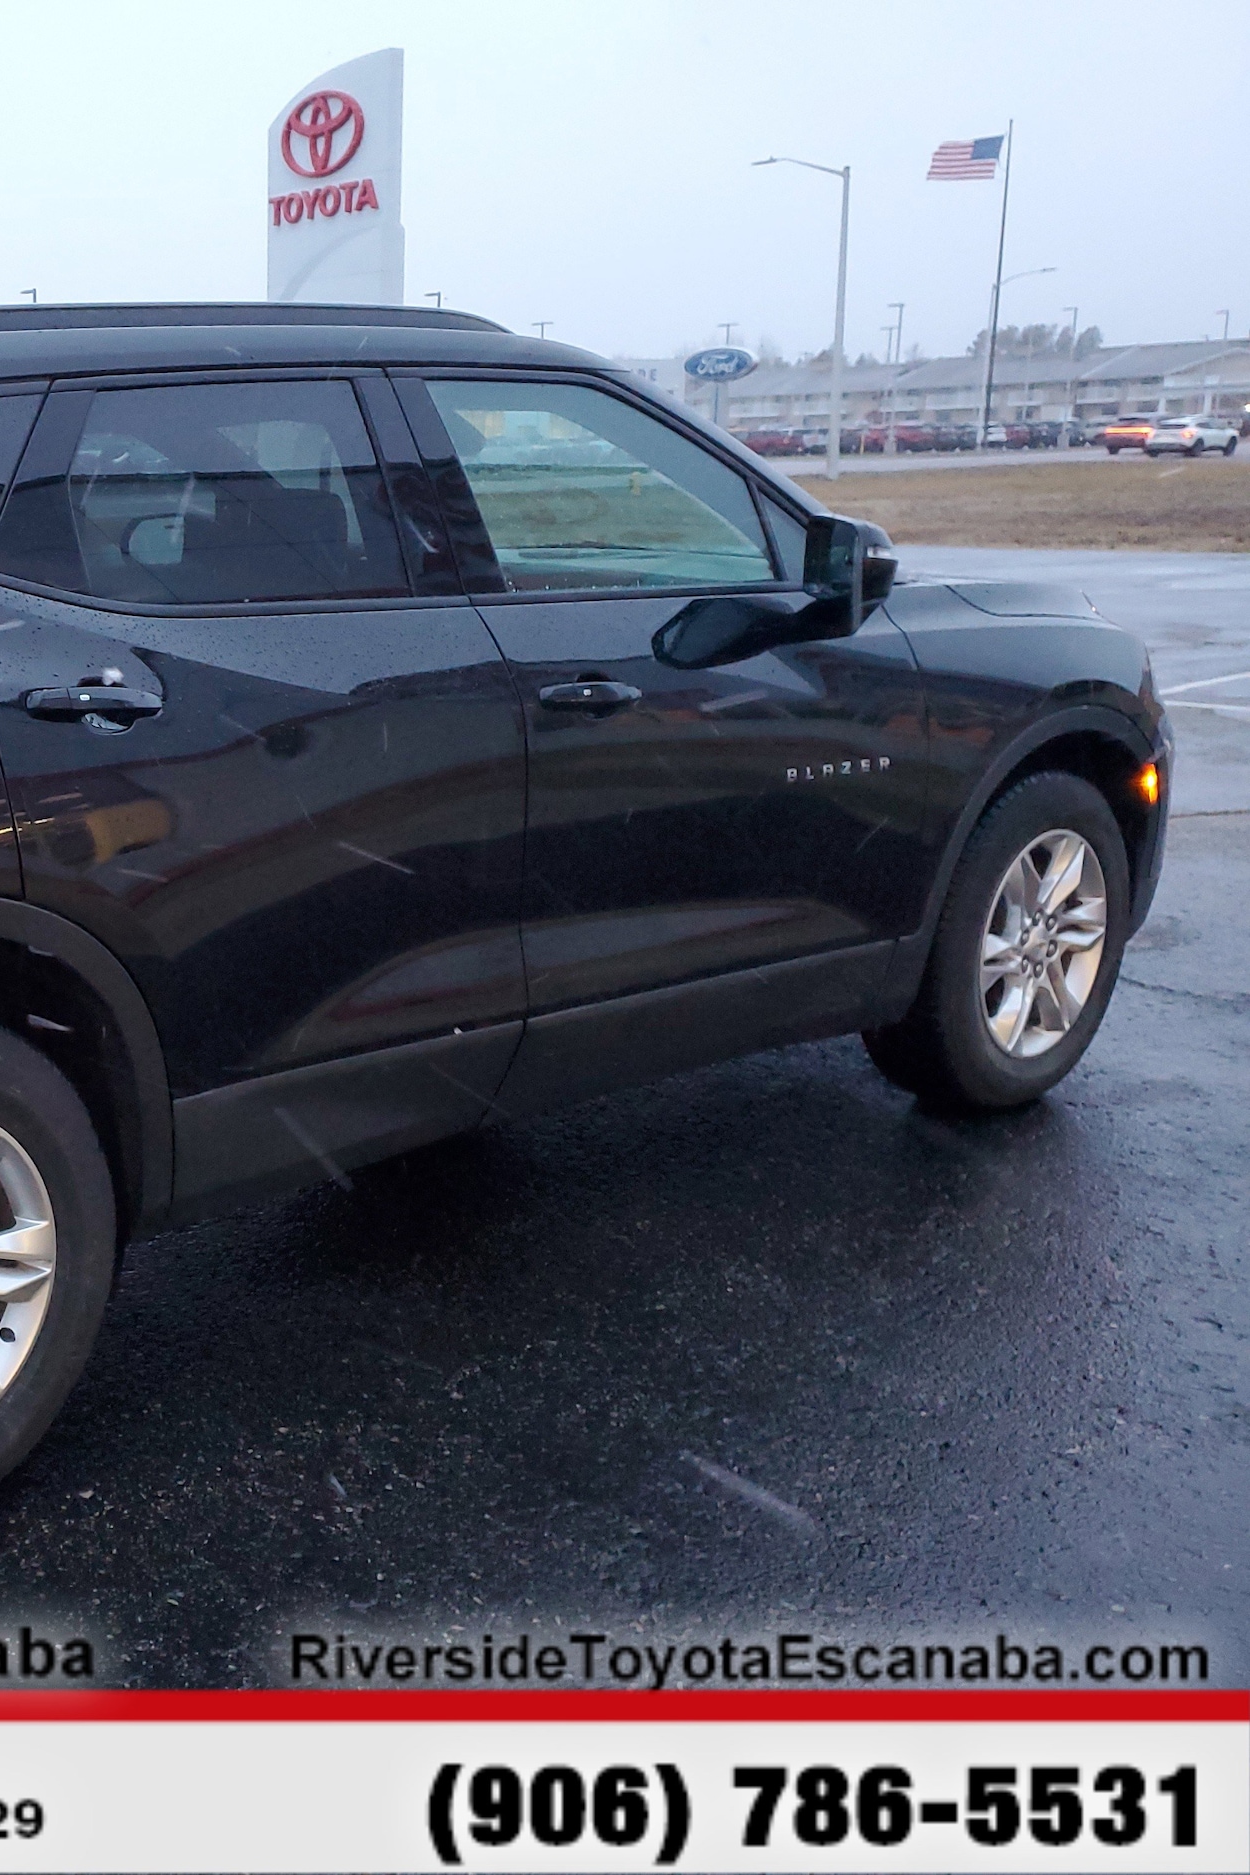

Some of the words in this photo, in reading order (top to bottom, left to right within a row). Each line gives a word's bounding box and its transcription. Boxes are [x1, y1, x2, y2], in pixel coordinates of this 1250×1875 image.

[269, 179, 379, 226] TOYOTA
[697, 354, 739, 374] Ford
[786, 756, 891, 782] BLAZER
